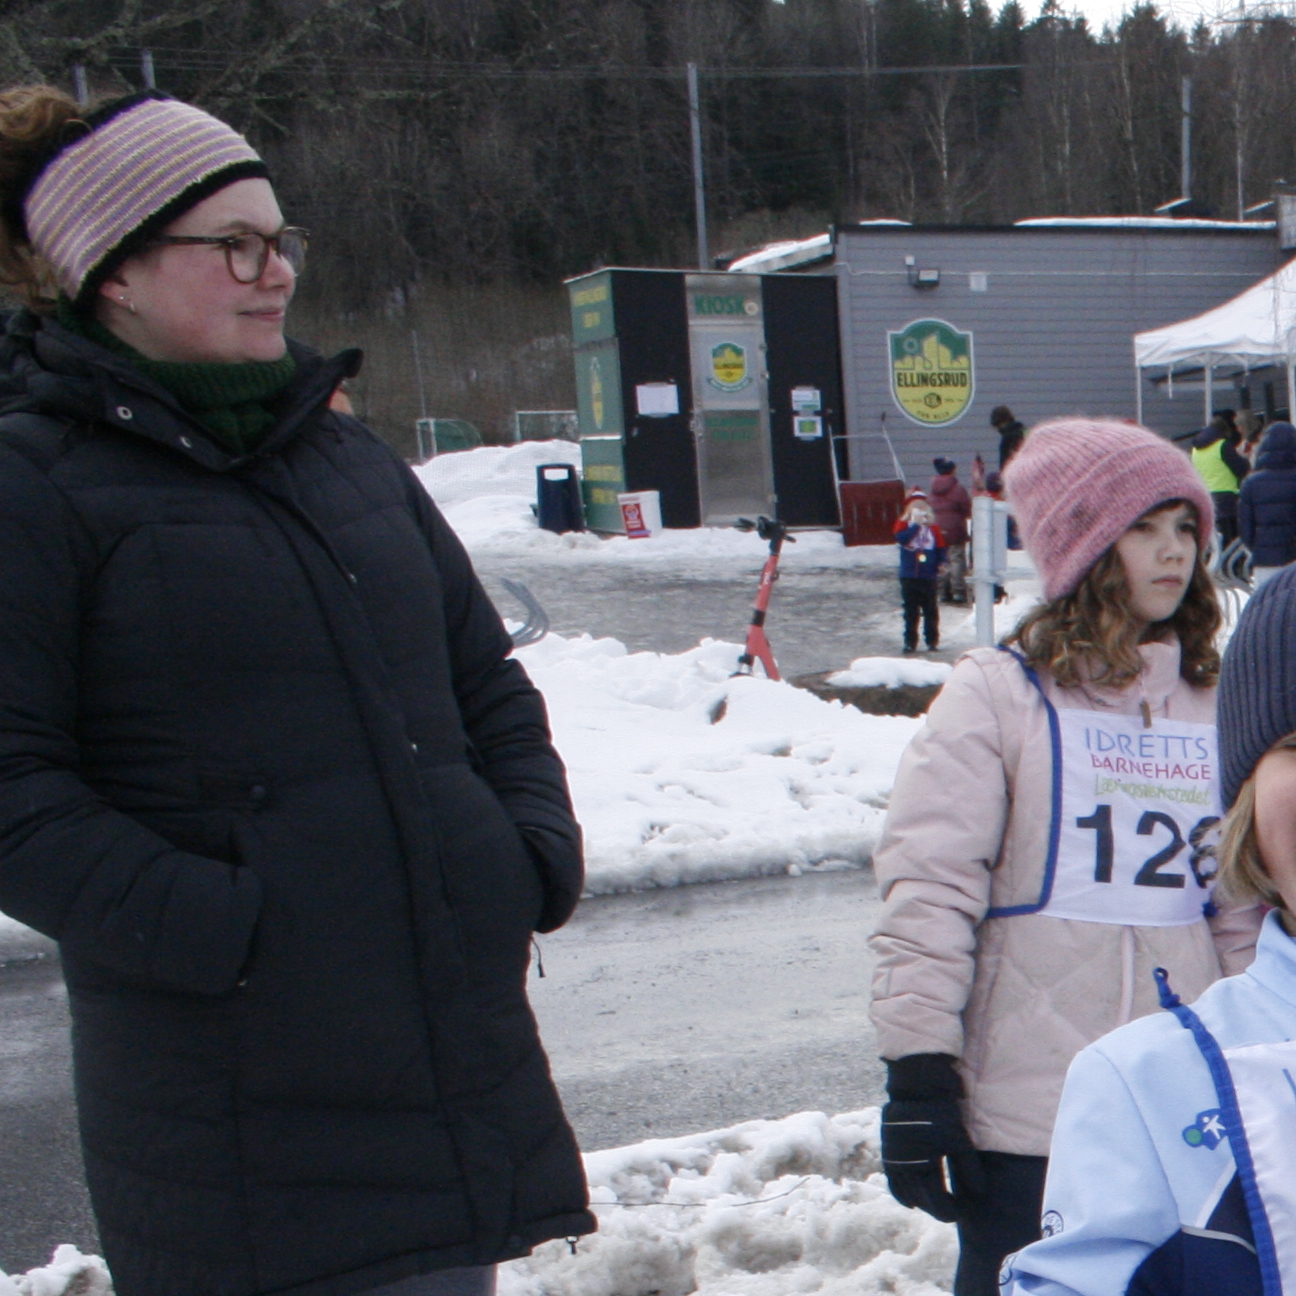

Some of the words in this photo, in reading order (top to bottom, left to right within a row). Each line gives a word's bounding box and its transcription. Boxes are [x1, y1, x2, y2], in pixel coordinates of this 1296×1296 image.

[694, 295, 747, 315] KIOSK
[896, 372, 968, 388] ELLINGSRUD
[1085, 727, 1209, 760] IDRETTS
[1090, 753, 1211, 781] BARNEHAGE
